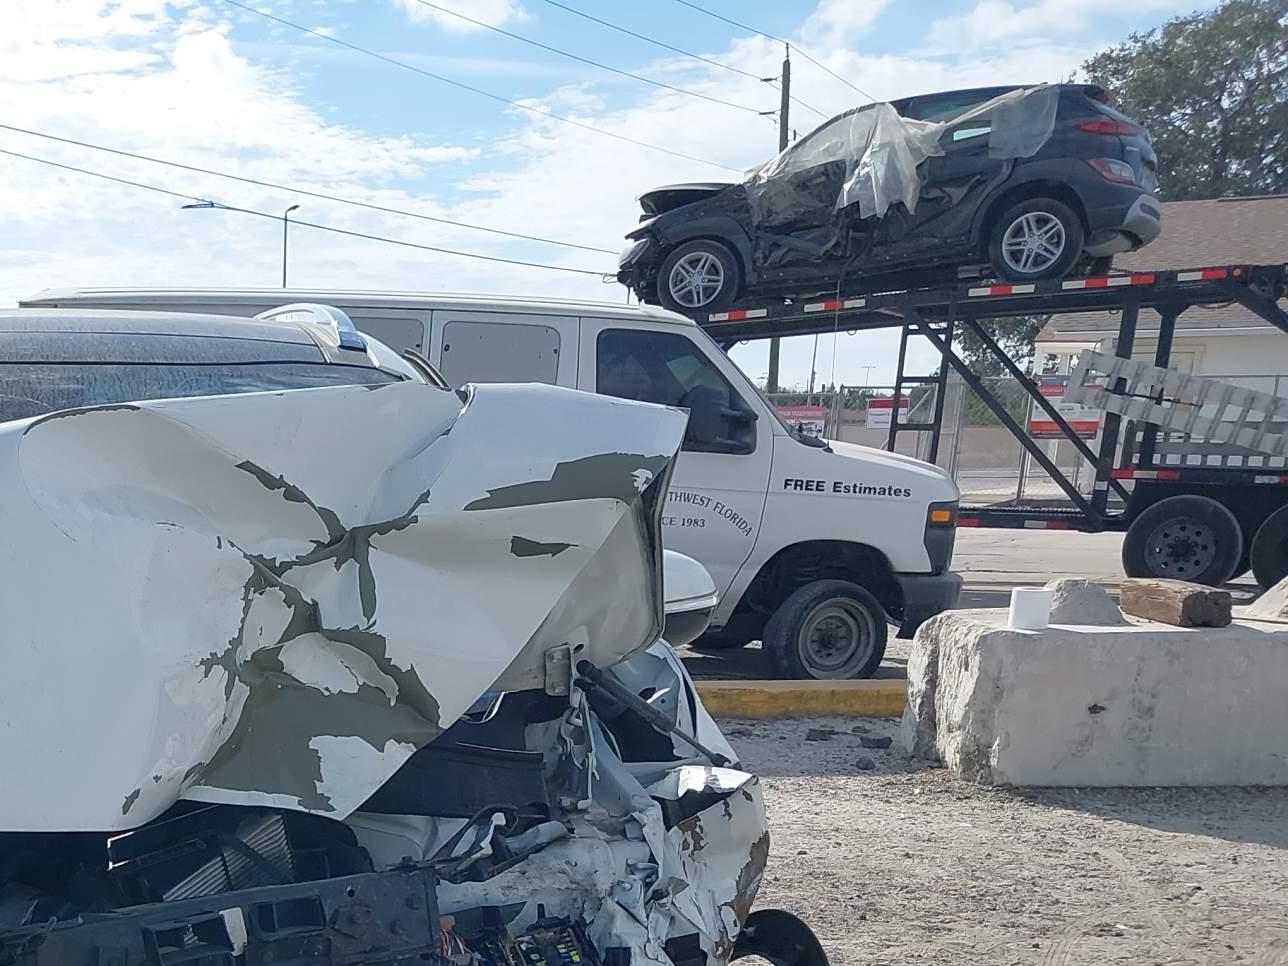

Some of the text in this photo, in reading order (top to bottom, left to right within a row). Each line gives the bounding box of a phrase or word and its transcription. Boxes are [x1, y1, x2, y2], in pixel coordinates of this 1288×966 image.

[783, 478, 912, 497] FREE Estimates
[668, 491, 753, 537] THWEST FLORIDA
[681, 517, 706, 528] 1983
